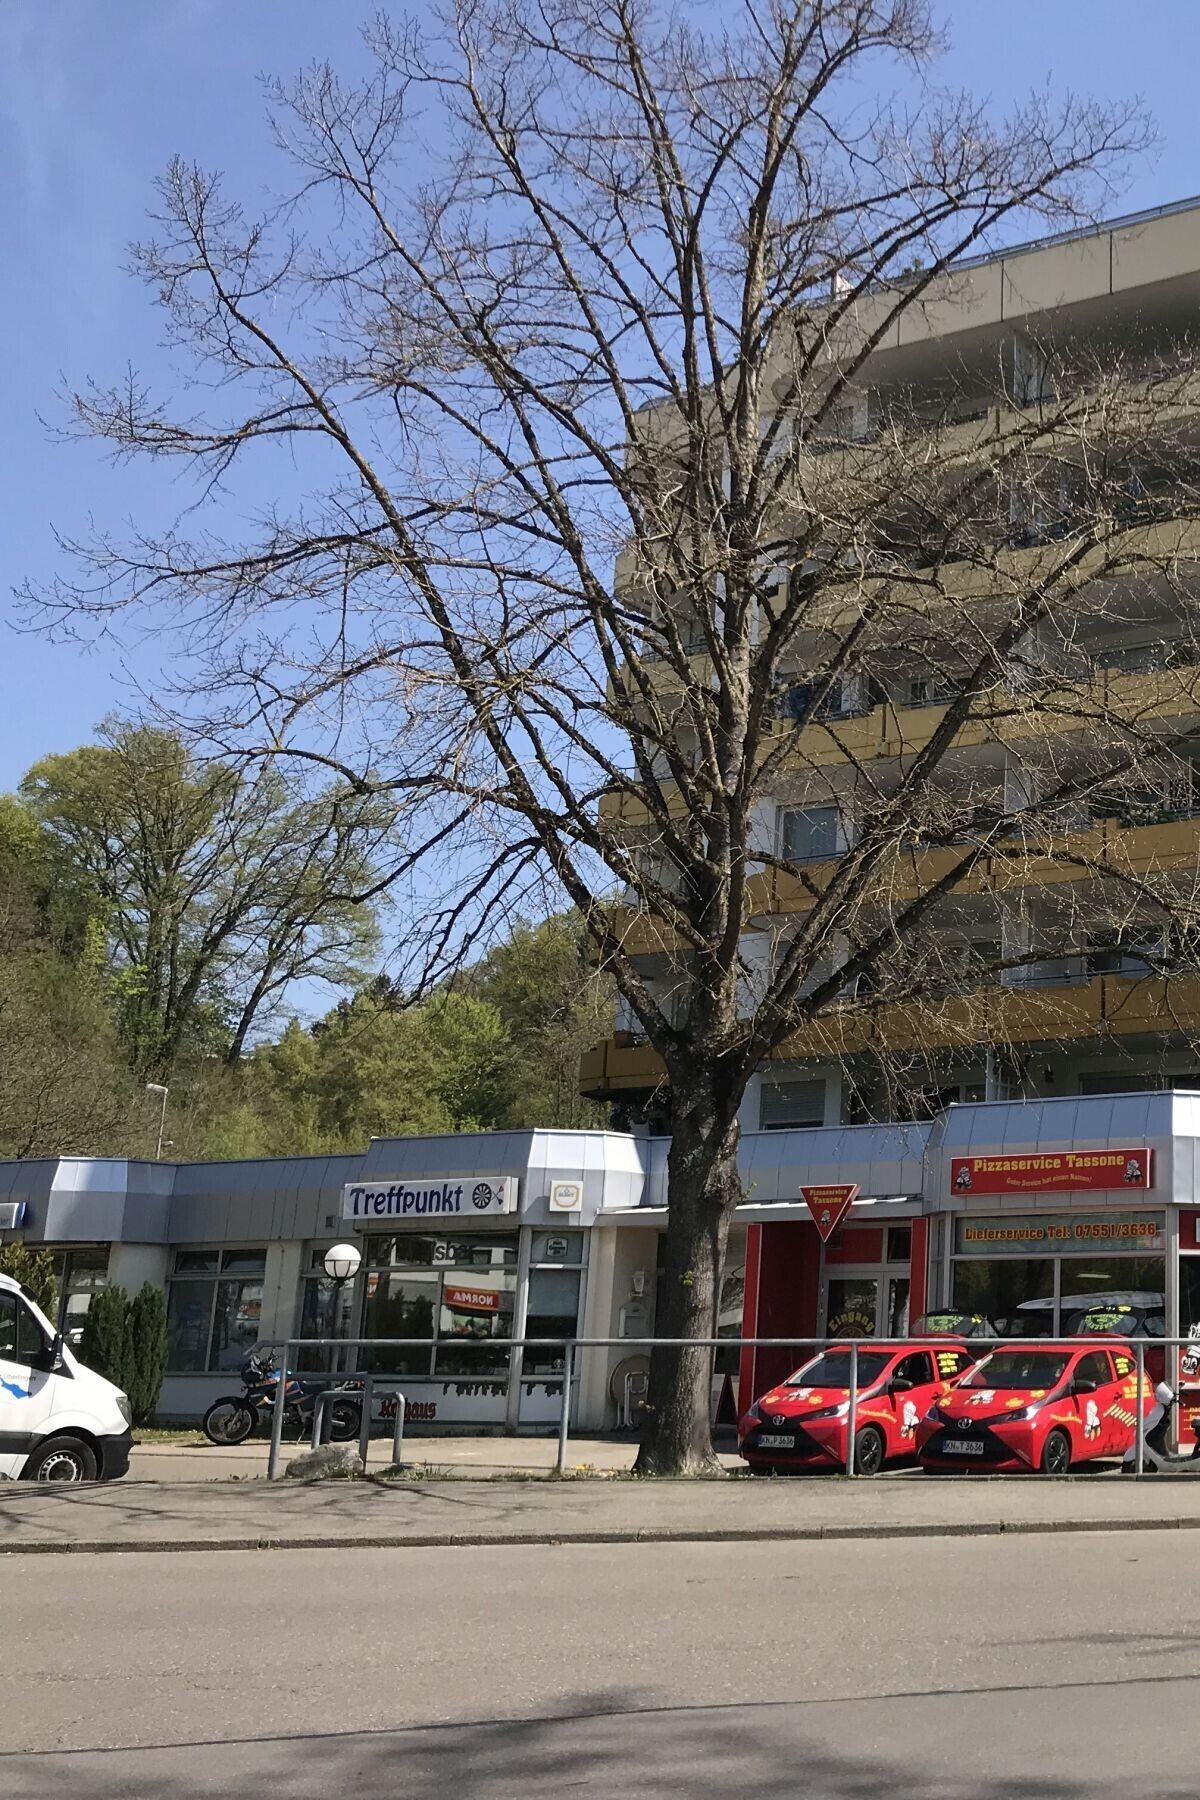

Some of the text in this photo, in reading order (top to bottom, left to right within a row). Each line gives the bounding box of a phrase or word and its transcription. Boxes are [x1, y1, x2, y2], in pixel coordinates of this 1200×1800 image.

[973, 1154, 1125, 1172] Pizzaservice Tassone
[349, 1183, 463, 1215] Treffpunkt
[964, 1226, 1044, 1241] Lieferservice
[828, 1311, 875, 1333] Eingang
[378, 1397, 438, 1421] Rohaus
